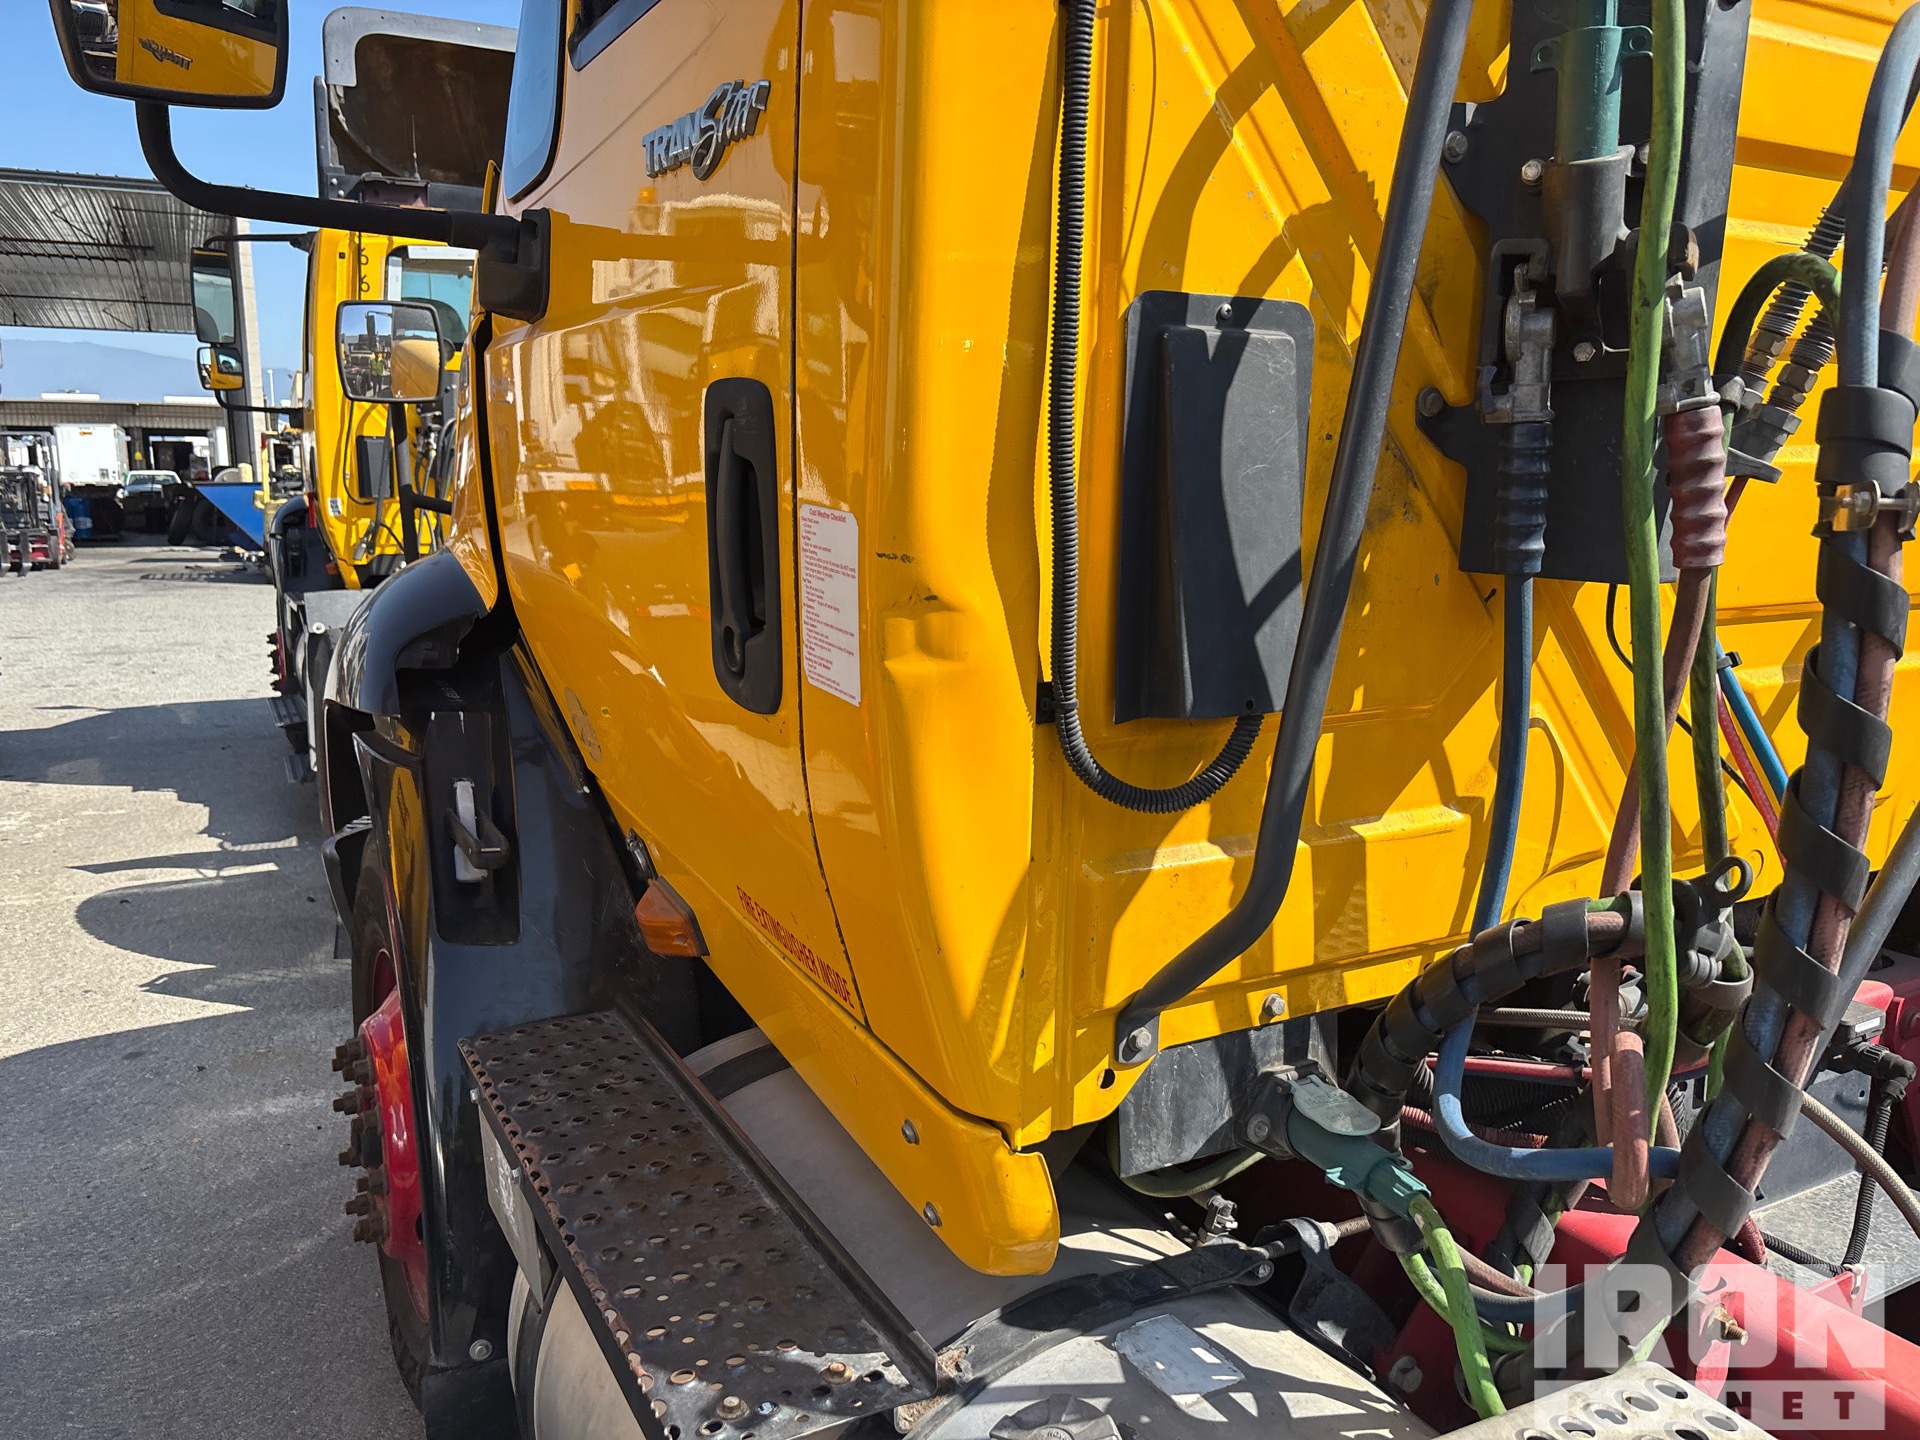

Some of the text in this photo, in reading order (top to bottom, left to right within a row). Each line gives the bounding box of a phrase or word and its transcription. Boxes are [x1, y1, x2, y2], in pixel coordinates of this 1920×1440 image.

[818, 510, 831, 519] Weather
[831, 513, 846, 522] Checklist
[736, 885, 855, 1009] FIRE EXTINGUISHER INSIDE
